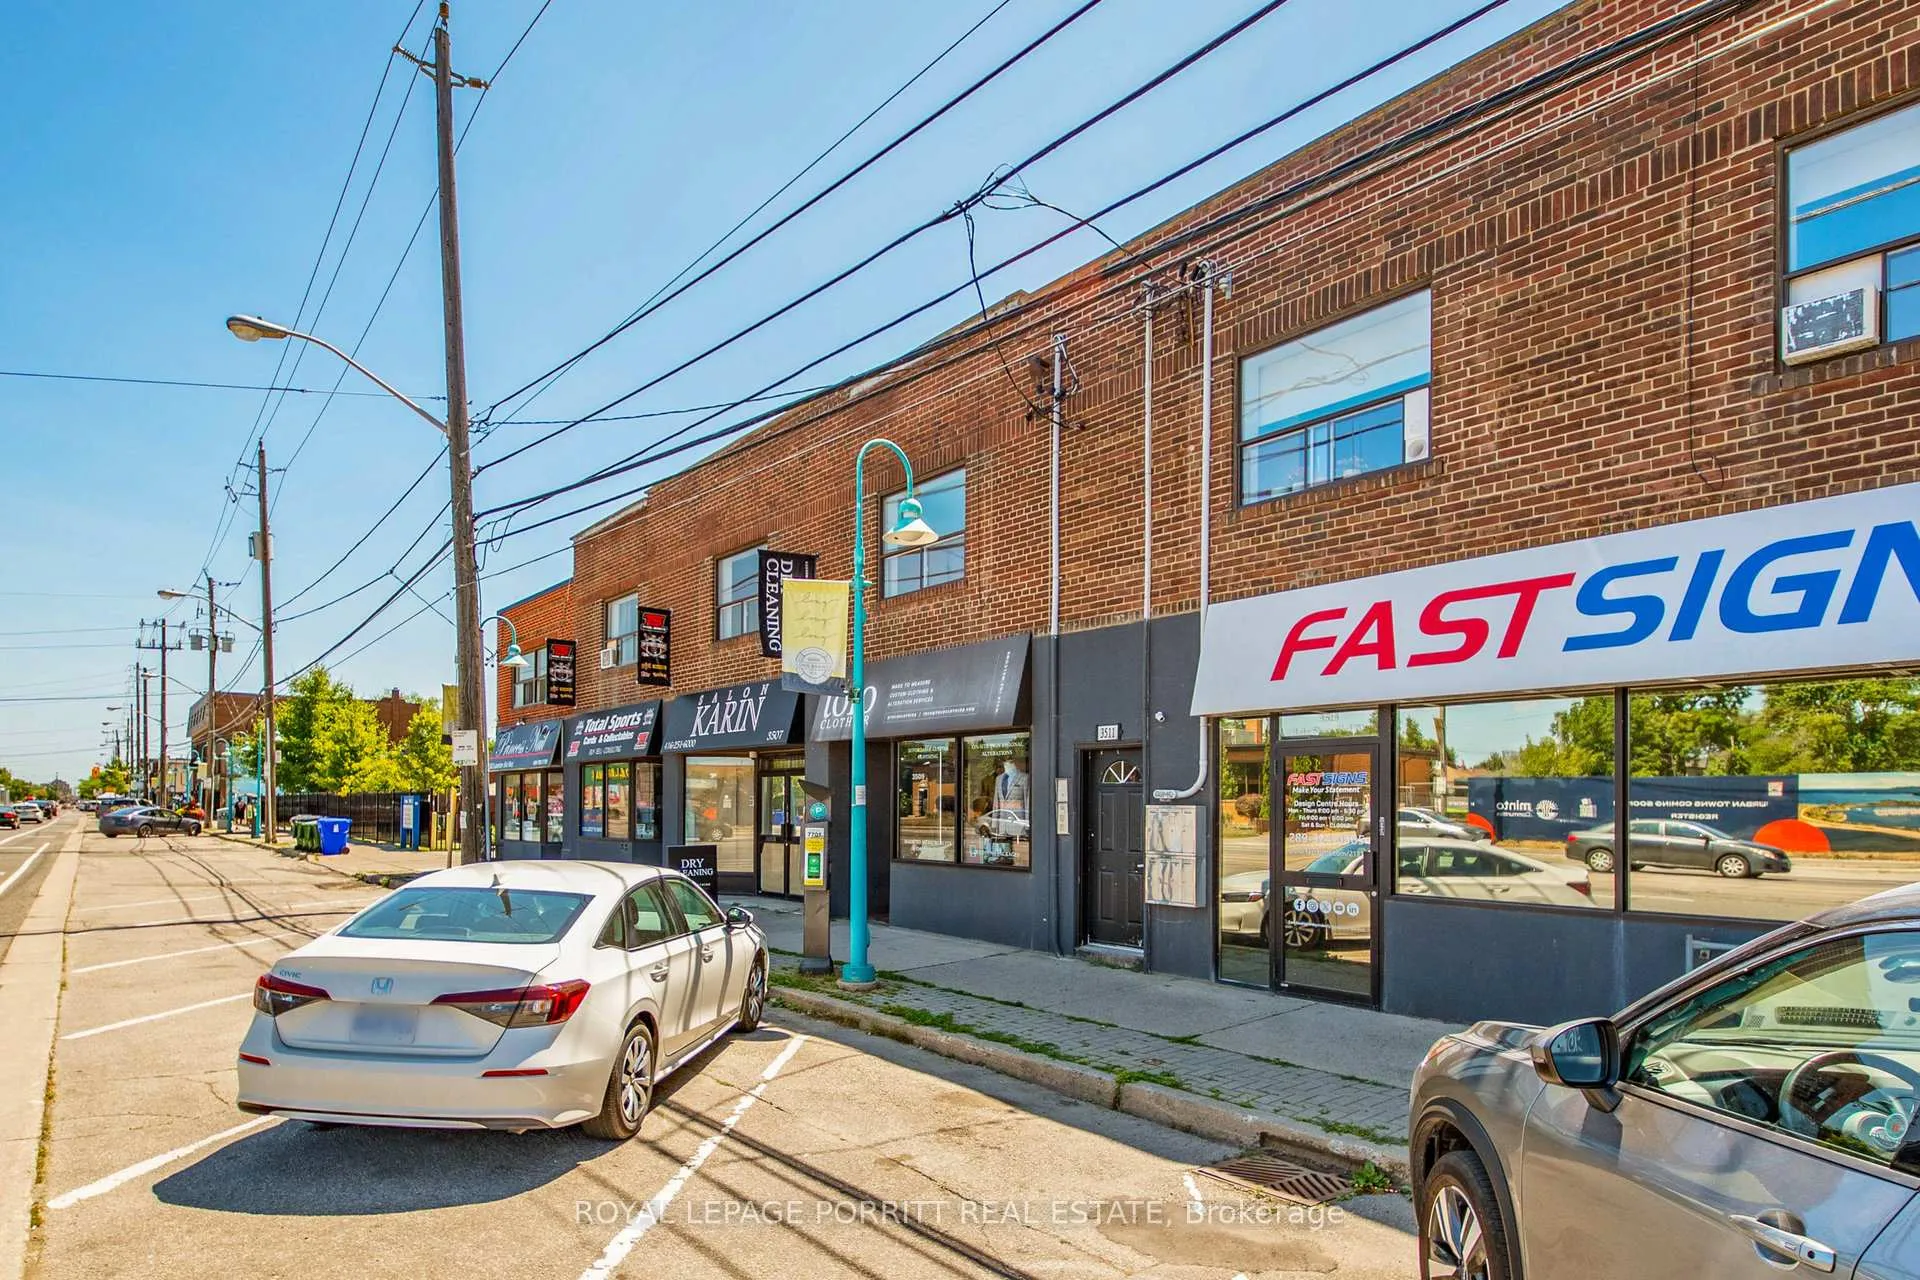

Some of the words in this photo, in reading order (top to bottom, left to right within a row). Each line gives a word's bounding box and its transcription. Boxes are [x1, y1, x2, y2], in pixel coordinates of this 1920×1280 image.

[766, 557, 782, 652] CLEANING
[698, 683, 770, 705] SALON
[583, 715, 610, 733] Total
[608, 711, 643, 731] Sports
[689, 696, 767, 737] KARIN
[820, 714, 870, 730] CLOTHR
[766, 730, 784, 741] 3507
[1099, 727, 1115, 739] 3511
[1287, 771, 1368, 785] FASTSIGNS
[1310, 786, 1325, 794] Your
[1325, 786, 1361, 794] Statement
[1294, 800, 1316, 808] Design
[681, 858, 704, 869] DRY
[681, 867, 714, 877] EANING
